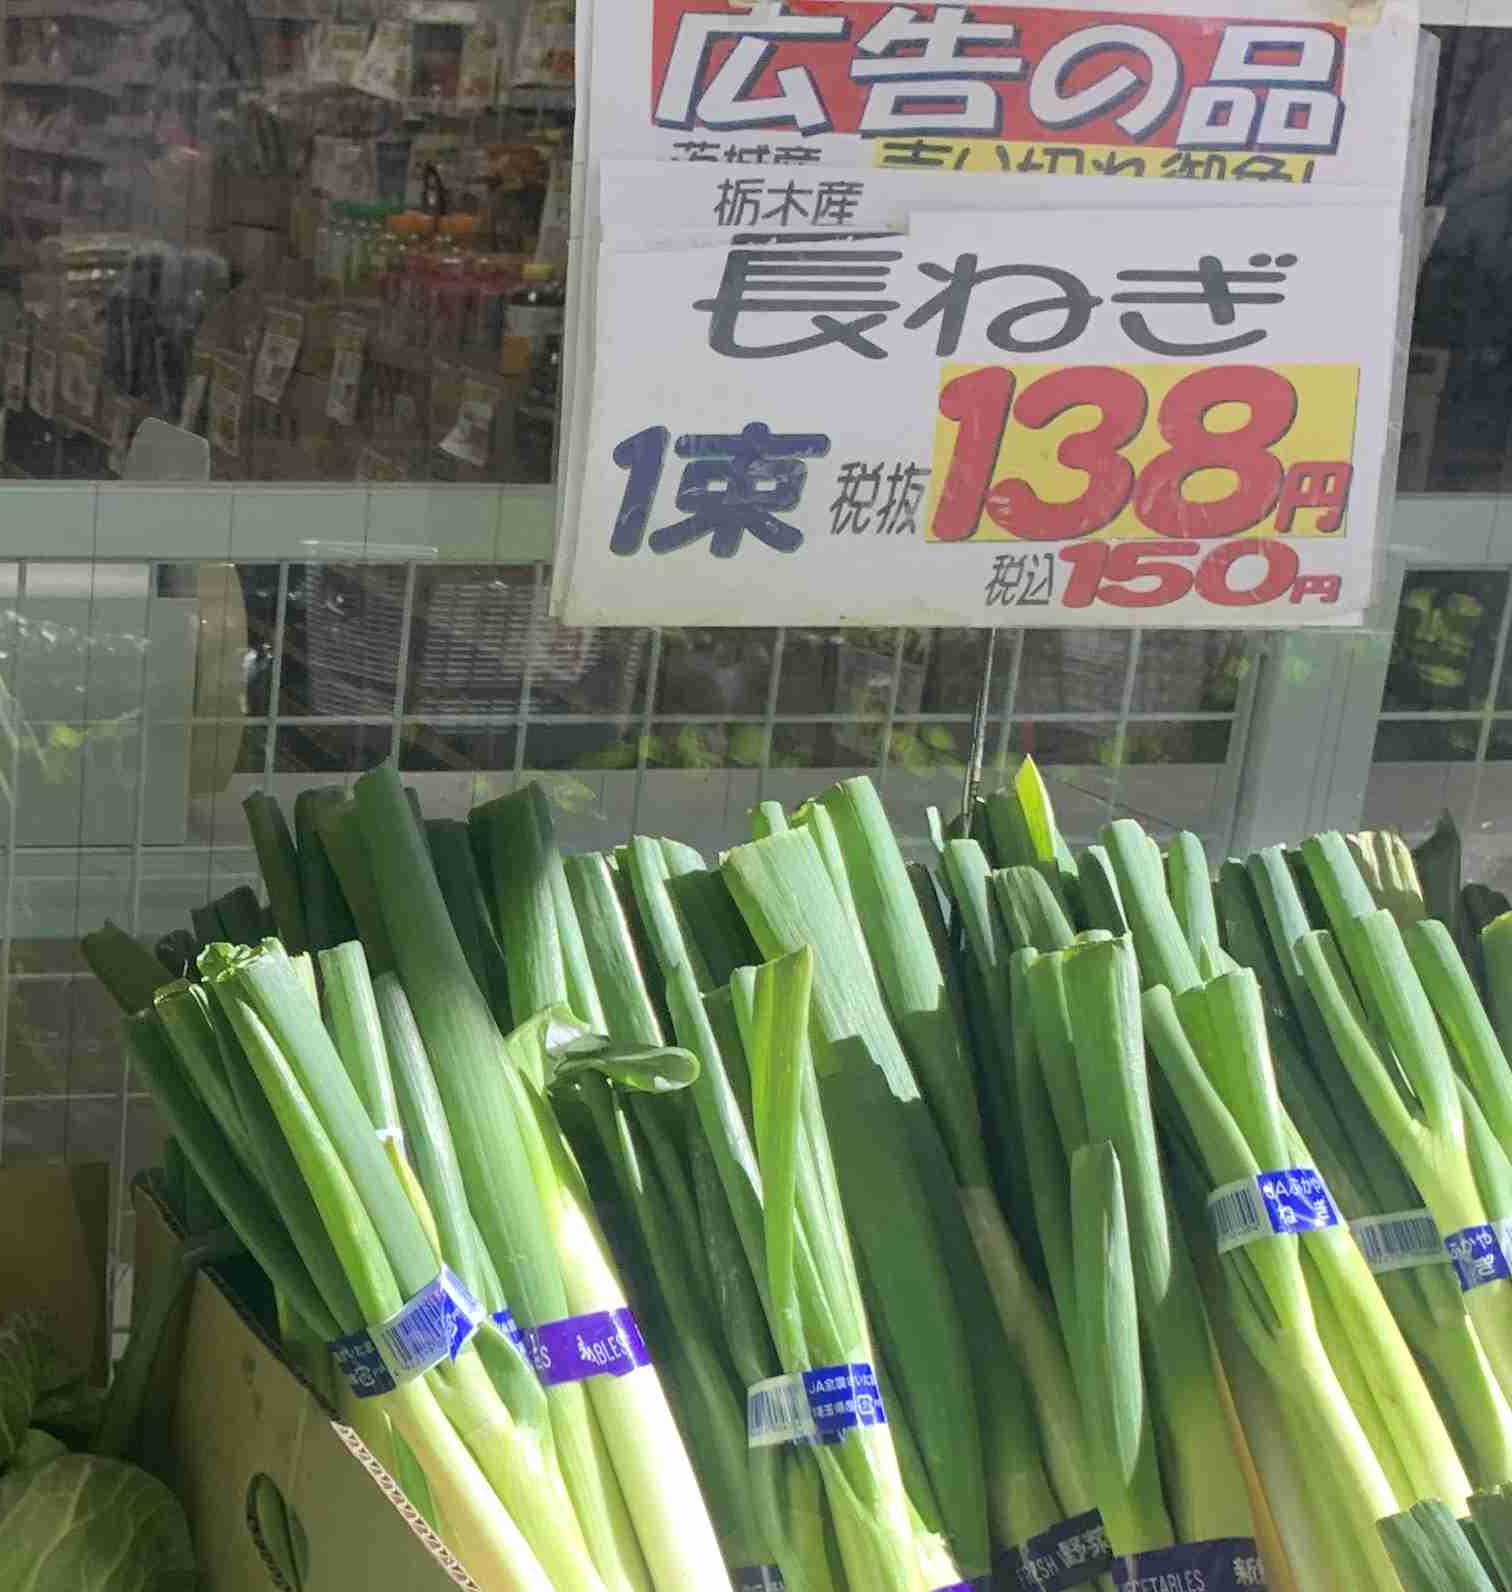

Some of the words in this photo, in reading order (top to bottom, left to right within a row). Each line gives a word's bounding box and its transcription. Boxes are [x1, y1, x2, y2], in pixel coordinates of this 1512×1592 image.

[654, 0, 1345, 154] 広告の品
[712, 177, 865, 228] 栃木産
[692, 230, 1299, 361] 長ねぎ
[609, 420, 833, 558] 1束
[829, 461, 932, 536] 税抜
[924, 363, 1354, 543] 138円
[985, 553, 1053, 605] 税込
[1058, 540, 1342, 609] 150円
